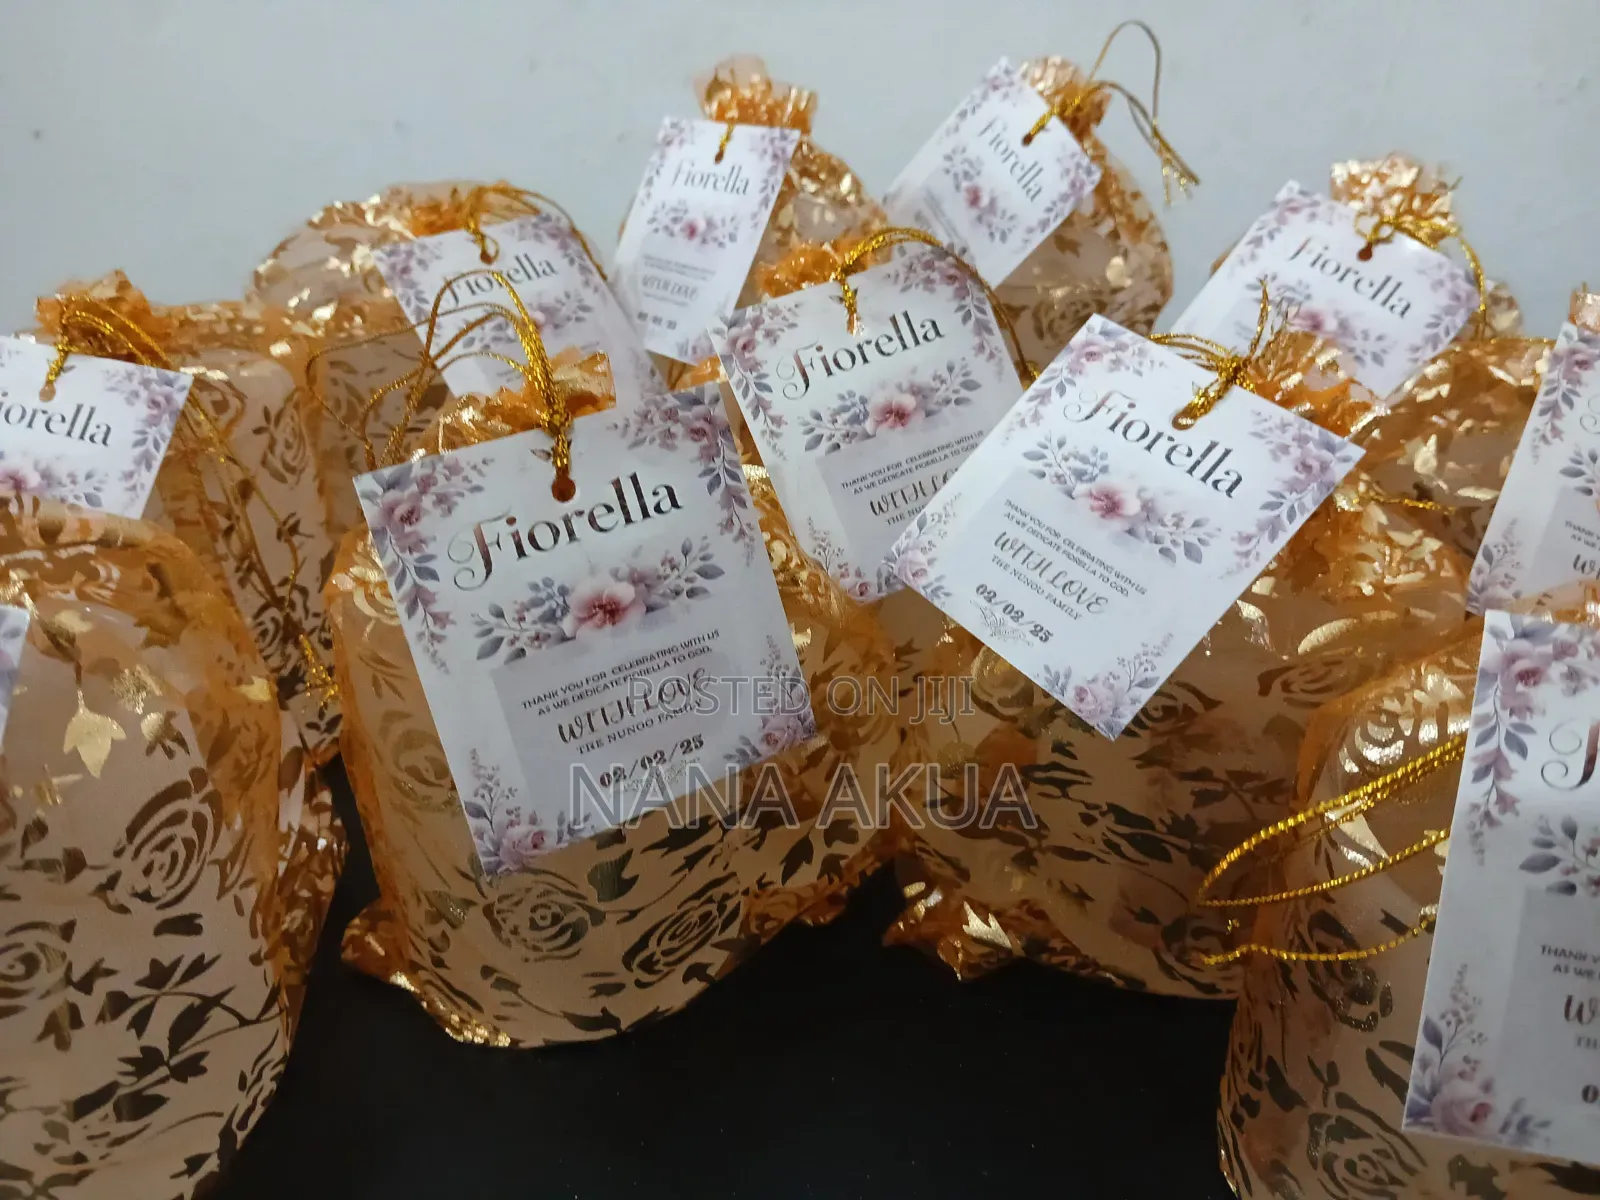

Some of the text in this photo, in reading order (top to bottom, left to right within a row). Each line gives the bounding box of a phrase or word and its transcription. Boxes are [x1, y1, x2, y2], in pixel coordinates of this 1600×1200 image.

[671, 158, 751, 196] Fiorella
[976, 116, 1045, 203] Fiorella
[1285, 235, 1414, 320] Fiorella
[775, 309, 946, 401] Fiorella
[868, 467, 886, 480] YOU
[886, 461, 903, 474] FOR
[905, 442, 955, 466] CELEBRATING
[877, 466, 914, 486] DEDICATE
[1062, 387, 1243, 499] Fiorella
[447, 471, 683, 591] Fiorella
[886, 511, 906, 526] THE
[1026, 525, 1063, 553] DEDICATE
[991, 553, 1011, 571] THE
[1045, 591, 1083, 621] FAMILY
[993, 530, 1109, 615] WITH LOVE
[1062, 537, 1114, 575] CELEBRATING
[521, 629, 720, 710] THANK YOU FOR CELEBRATING WITH US
[537, 705, 551, 717] AS
[552, 698, 570, 710] WE
[571, 679, 622, 703] DEDICATE
[622, 660, 671, 682] FIORELLA
[672, 653, 686, 665] TO
[557, 667, 711, 744] WITH LOVE
[575, 739, 605, 755] THE
[606, 717, 655, 743] NUNOO
